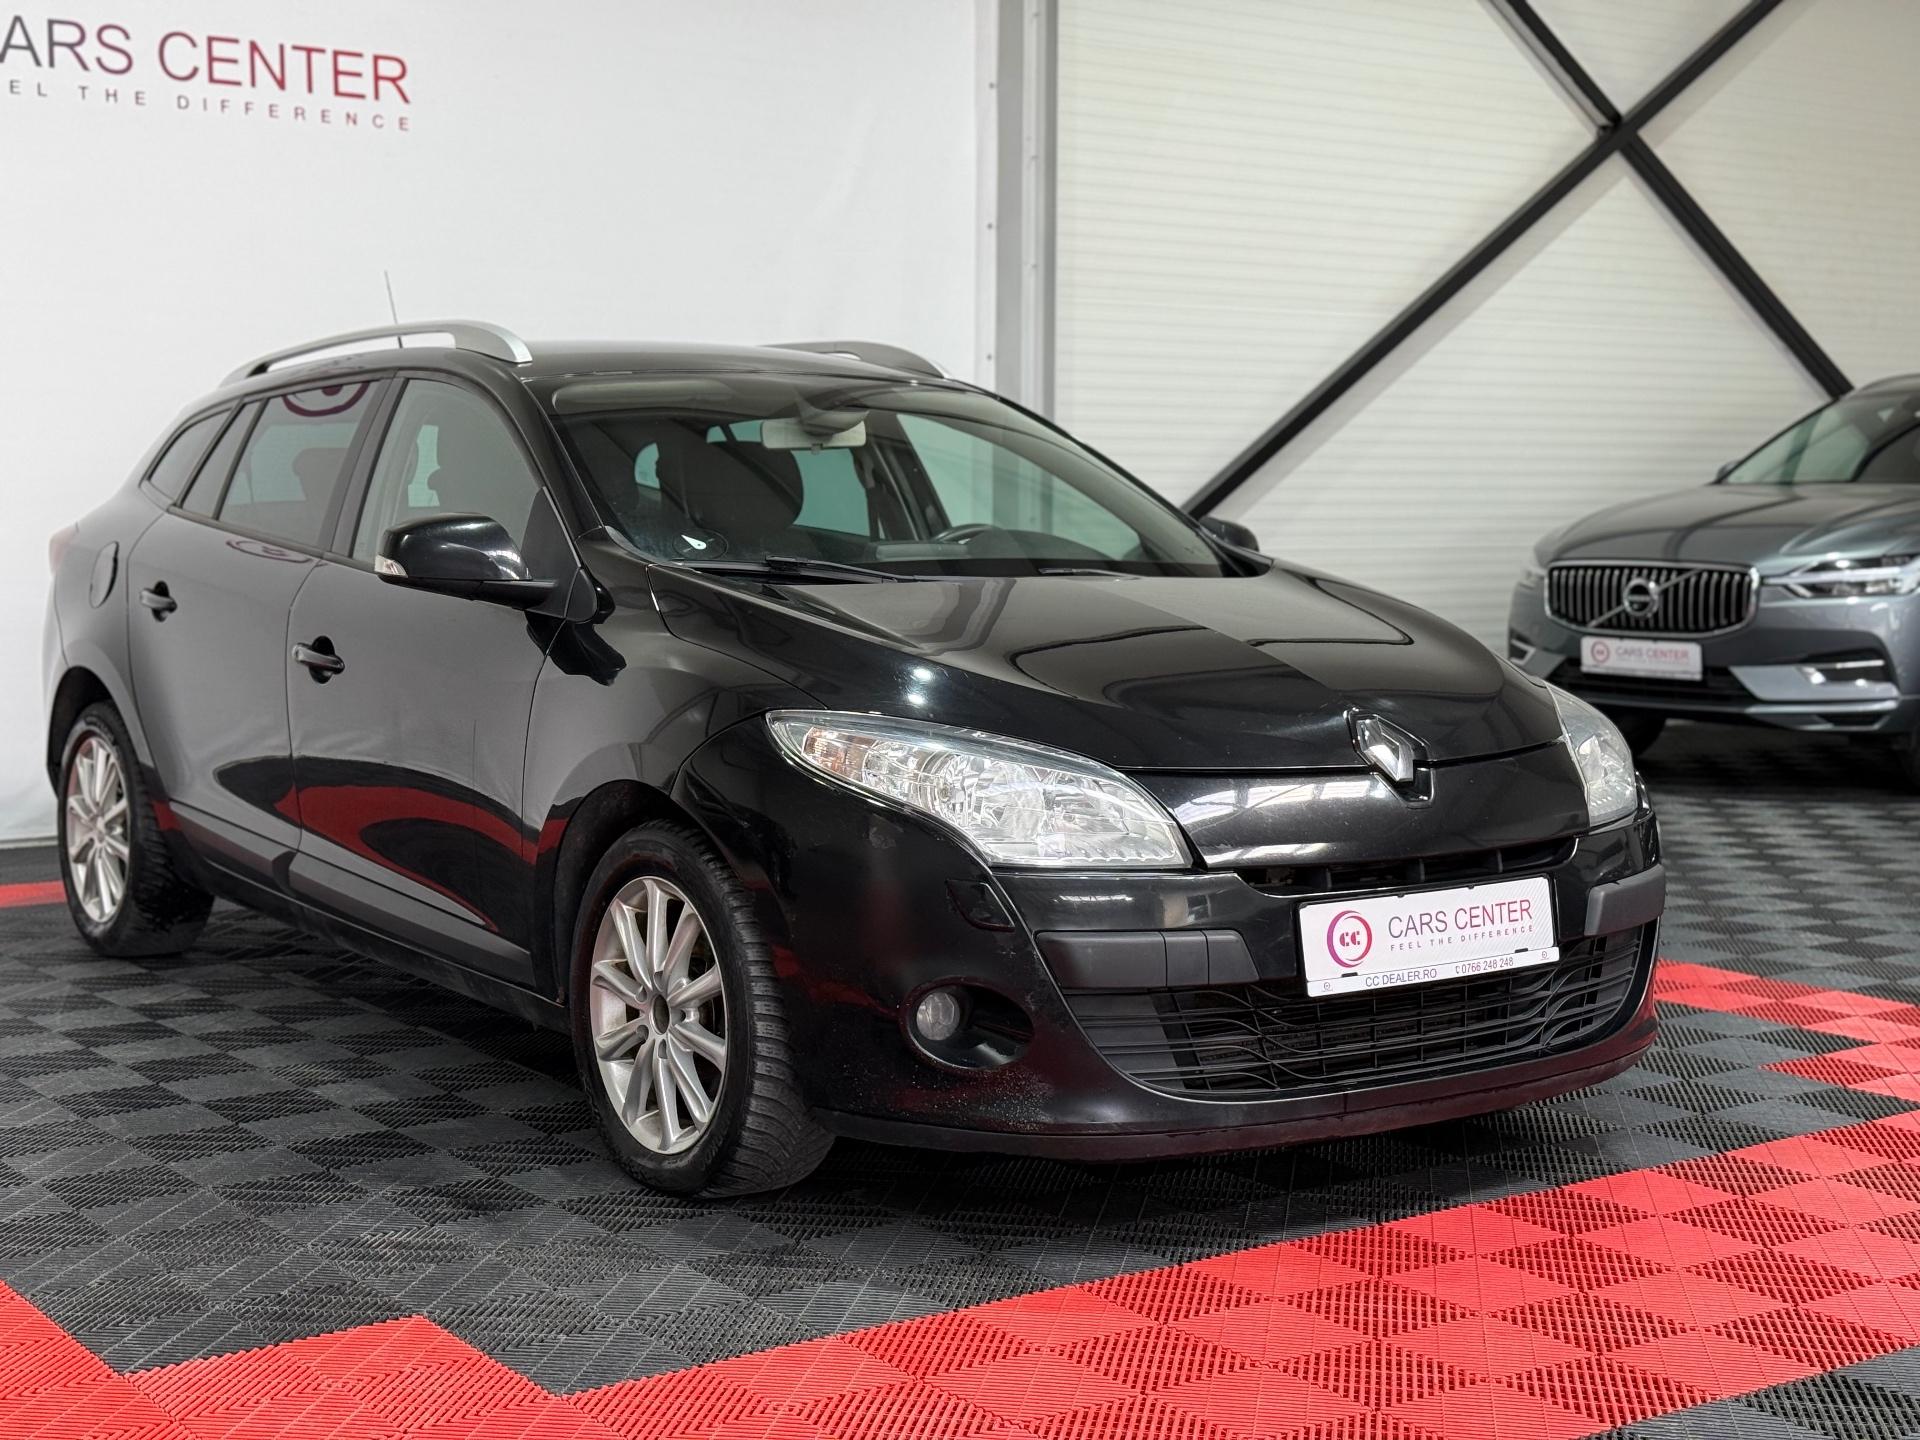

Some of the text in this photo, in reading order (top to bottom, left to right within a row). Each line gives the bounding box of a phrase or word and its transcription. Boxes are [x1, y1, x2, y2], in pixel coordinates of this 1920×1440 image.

[158, 31, 410, 104] CENTER
[78, 85, 146, 106] THE
[177, 94, 409, 131] DIFFERENCE
[1615, 646, 1643, 658] CARS
[1645, 648, 1690, 660] CENTER
[1388, 899, 1533, 939] CARS CENTER
[1390, 924, 1534, 951] FEEL THE DIFFERENCE
[1365, 976, 1380, 987] CC
